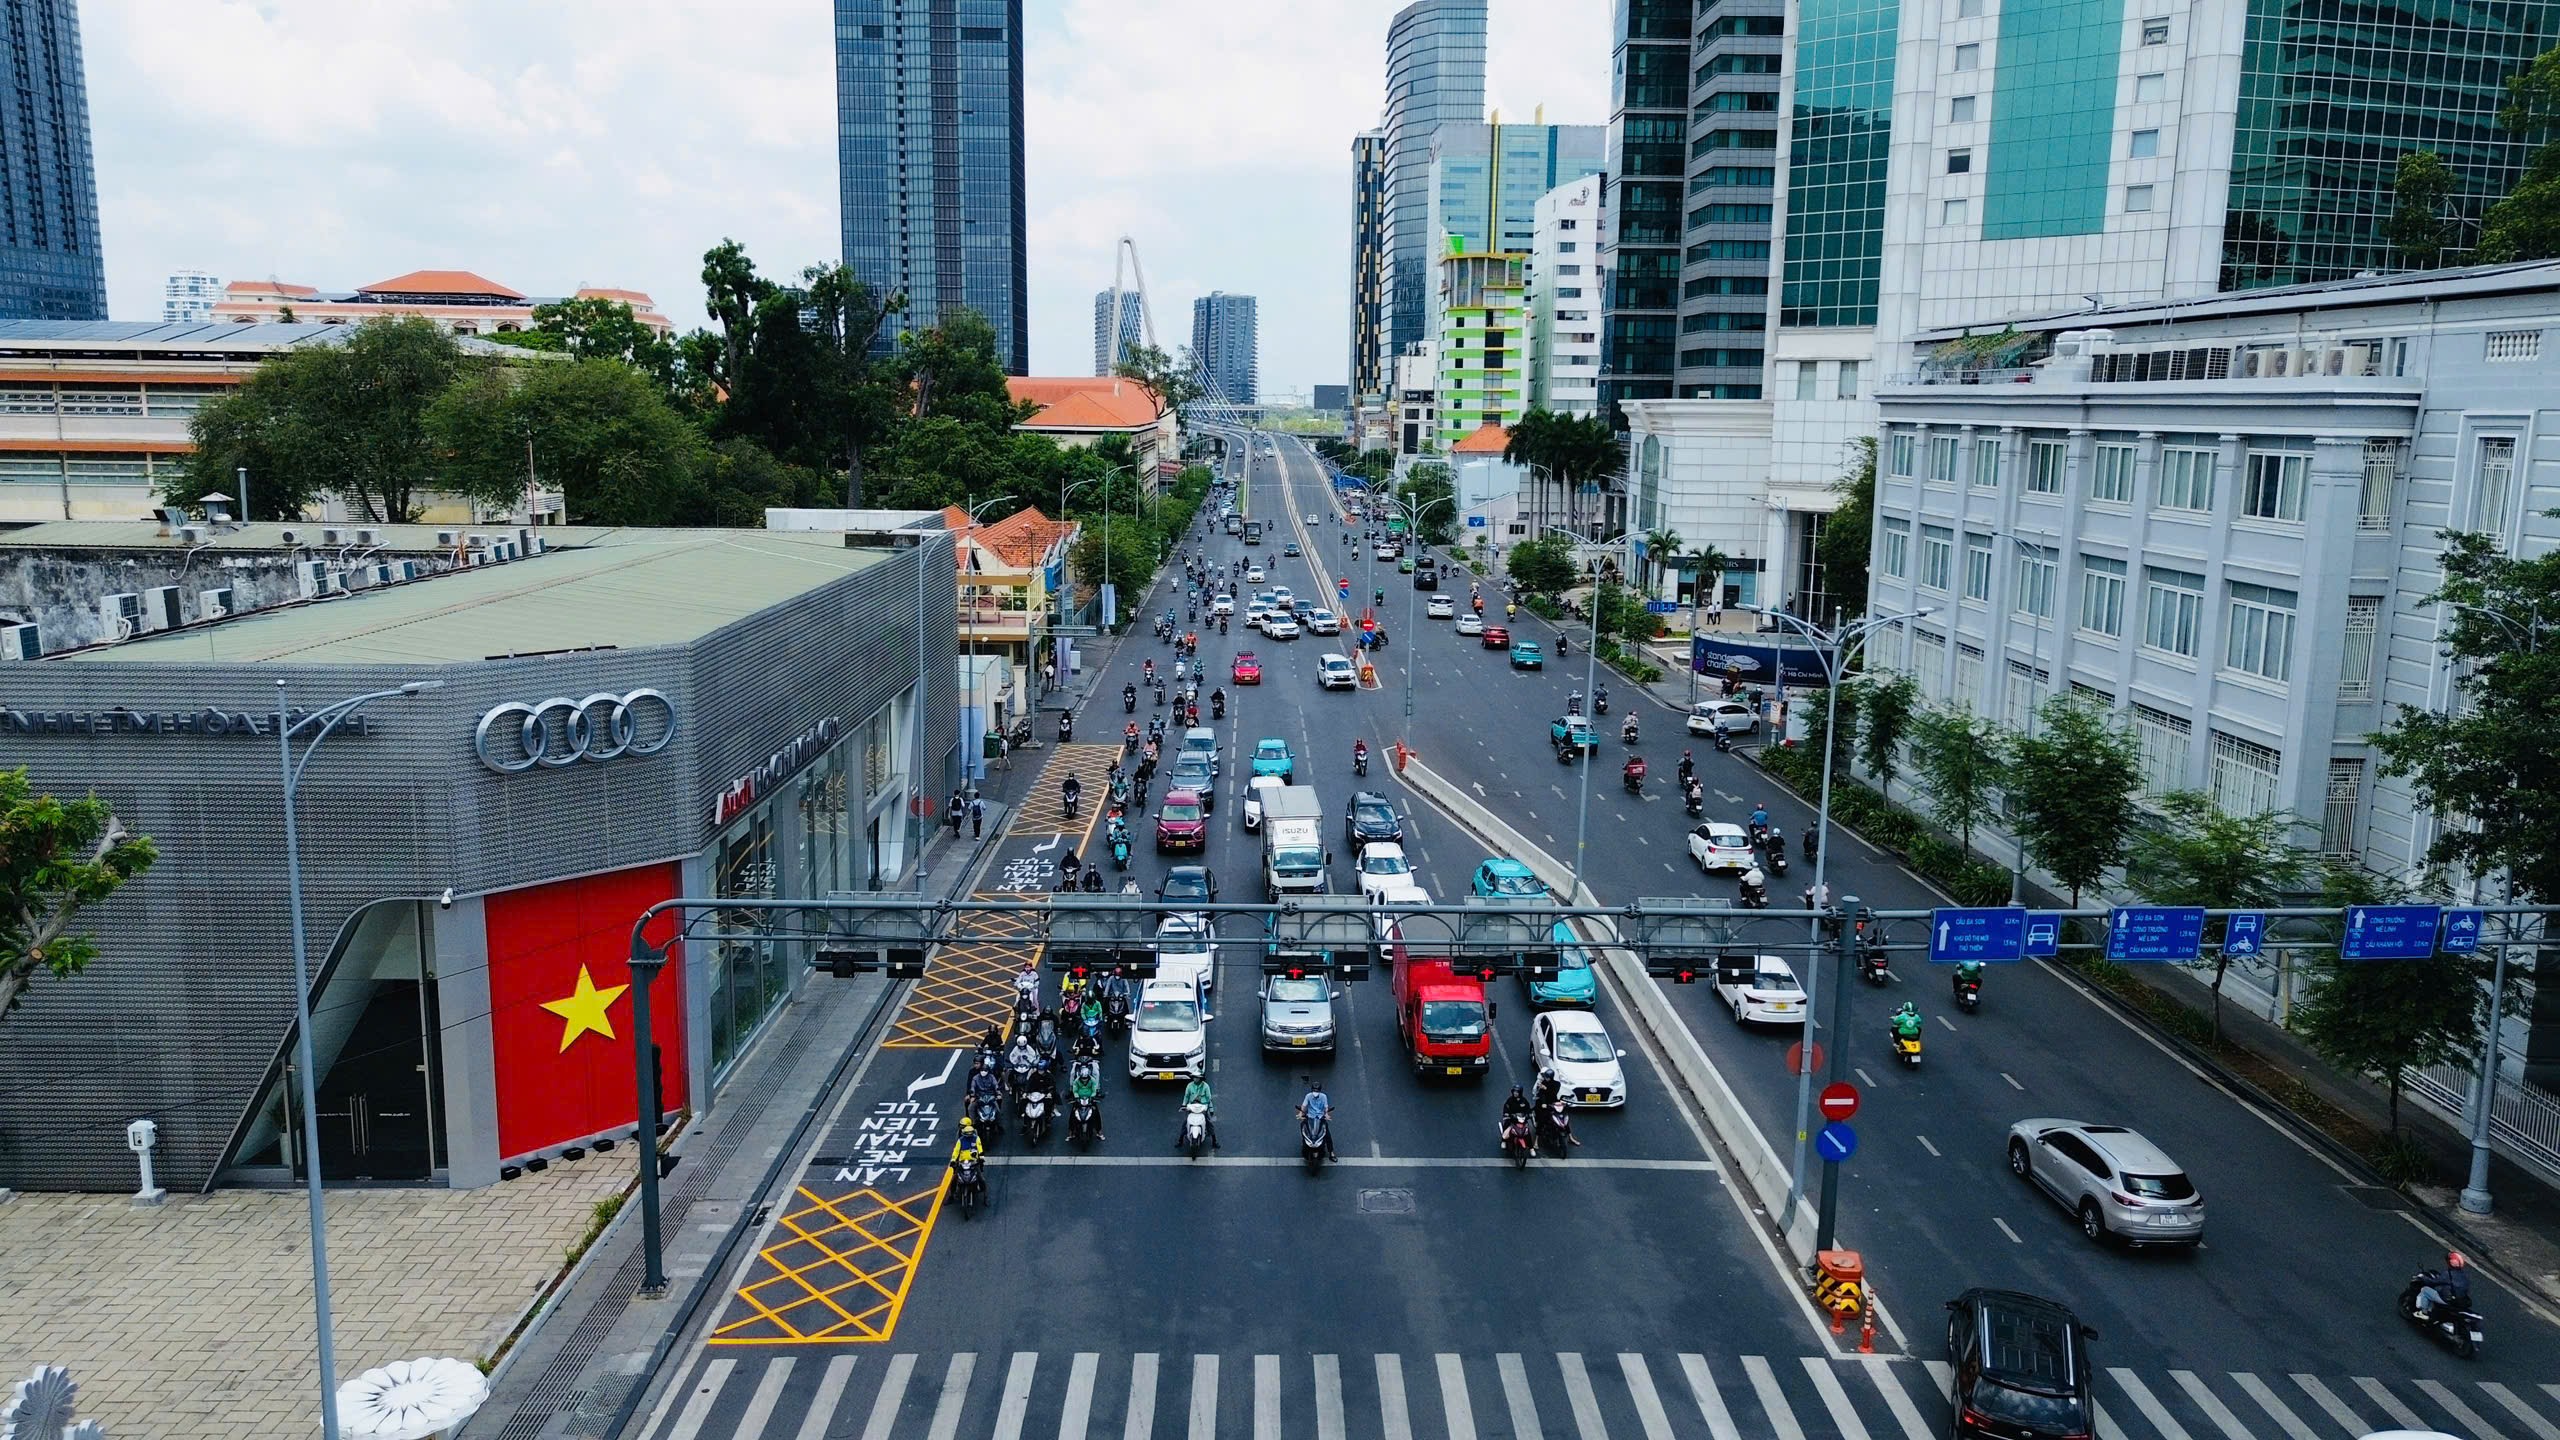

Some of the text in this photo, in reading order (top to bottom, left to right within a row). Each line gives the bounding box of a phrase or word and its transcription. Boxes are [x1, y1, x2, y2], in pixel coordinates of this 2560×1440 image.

[0, 706, 96, 734] NHH
[102, 709, 163, 734] TM
[715, 775, 750, 824] Audi
[873, 1099, 938, 1115] TỤC
[859, 1117, 940, 1134] LIÊN
[853, 1133, 937, 1150] PHẢI
[857, 1149, 908, 1167] RẼ
[833, 1167, 912, 1187] LÀN
